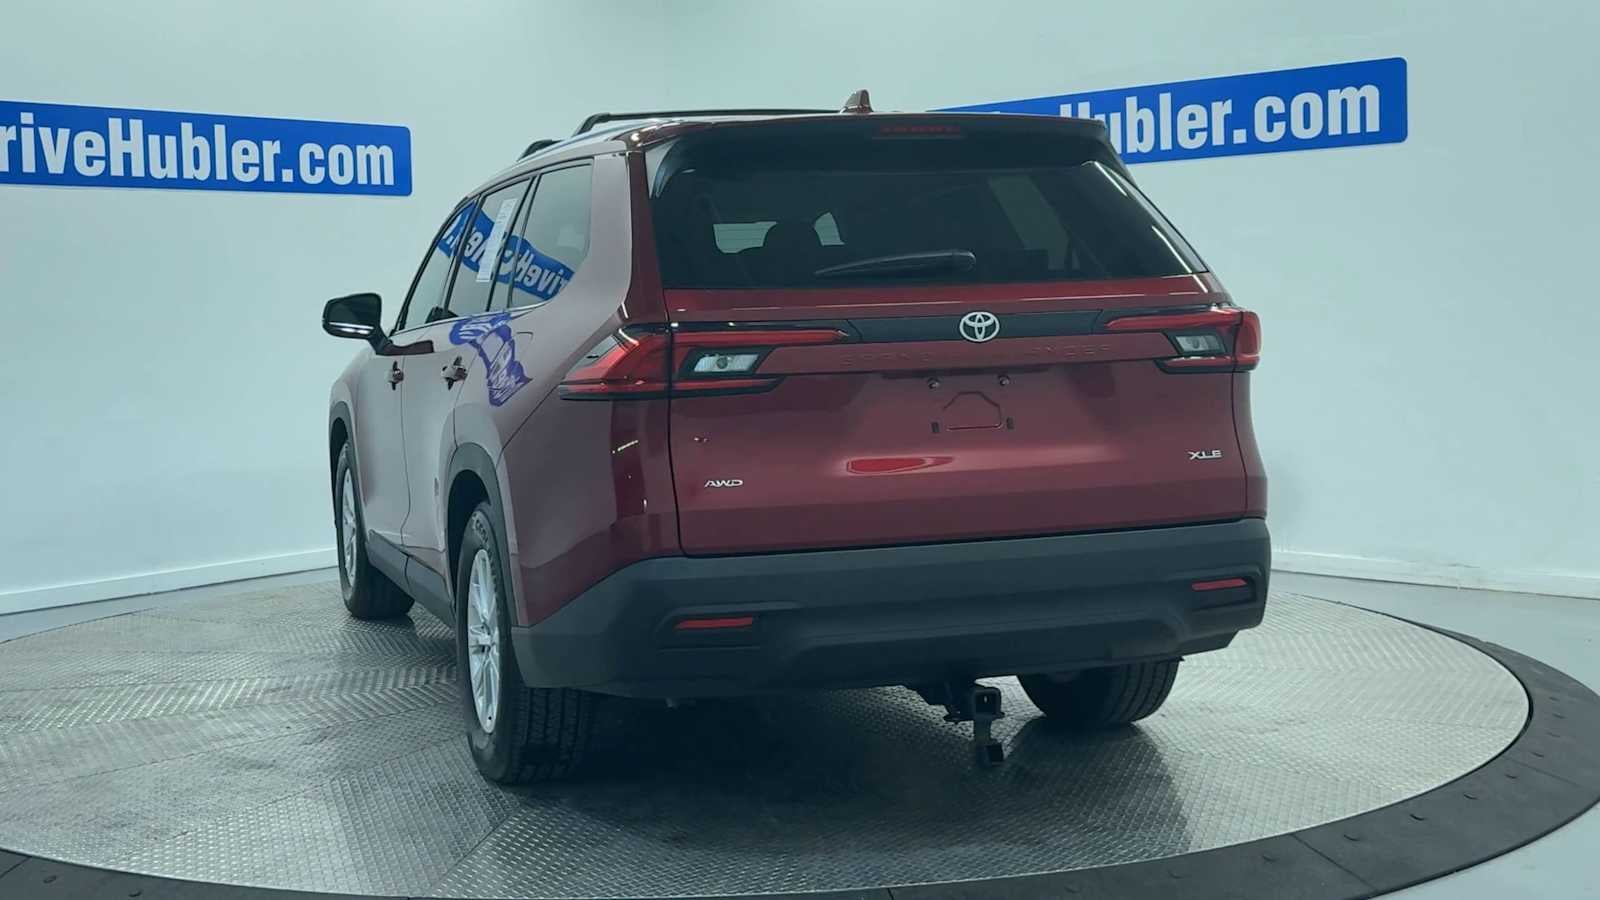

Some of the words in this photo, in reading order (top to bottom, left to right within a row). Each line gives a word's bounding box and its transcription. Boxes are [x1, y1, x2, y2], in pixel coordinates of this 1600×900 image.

[0, 112, 394, 186] riveHubler.com
[1187, 450, 1223, 460] XLE
[704, 479, 744, 488] AWD
